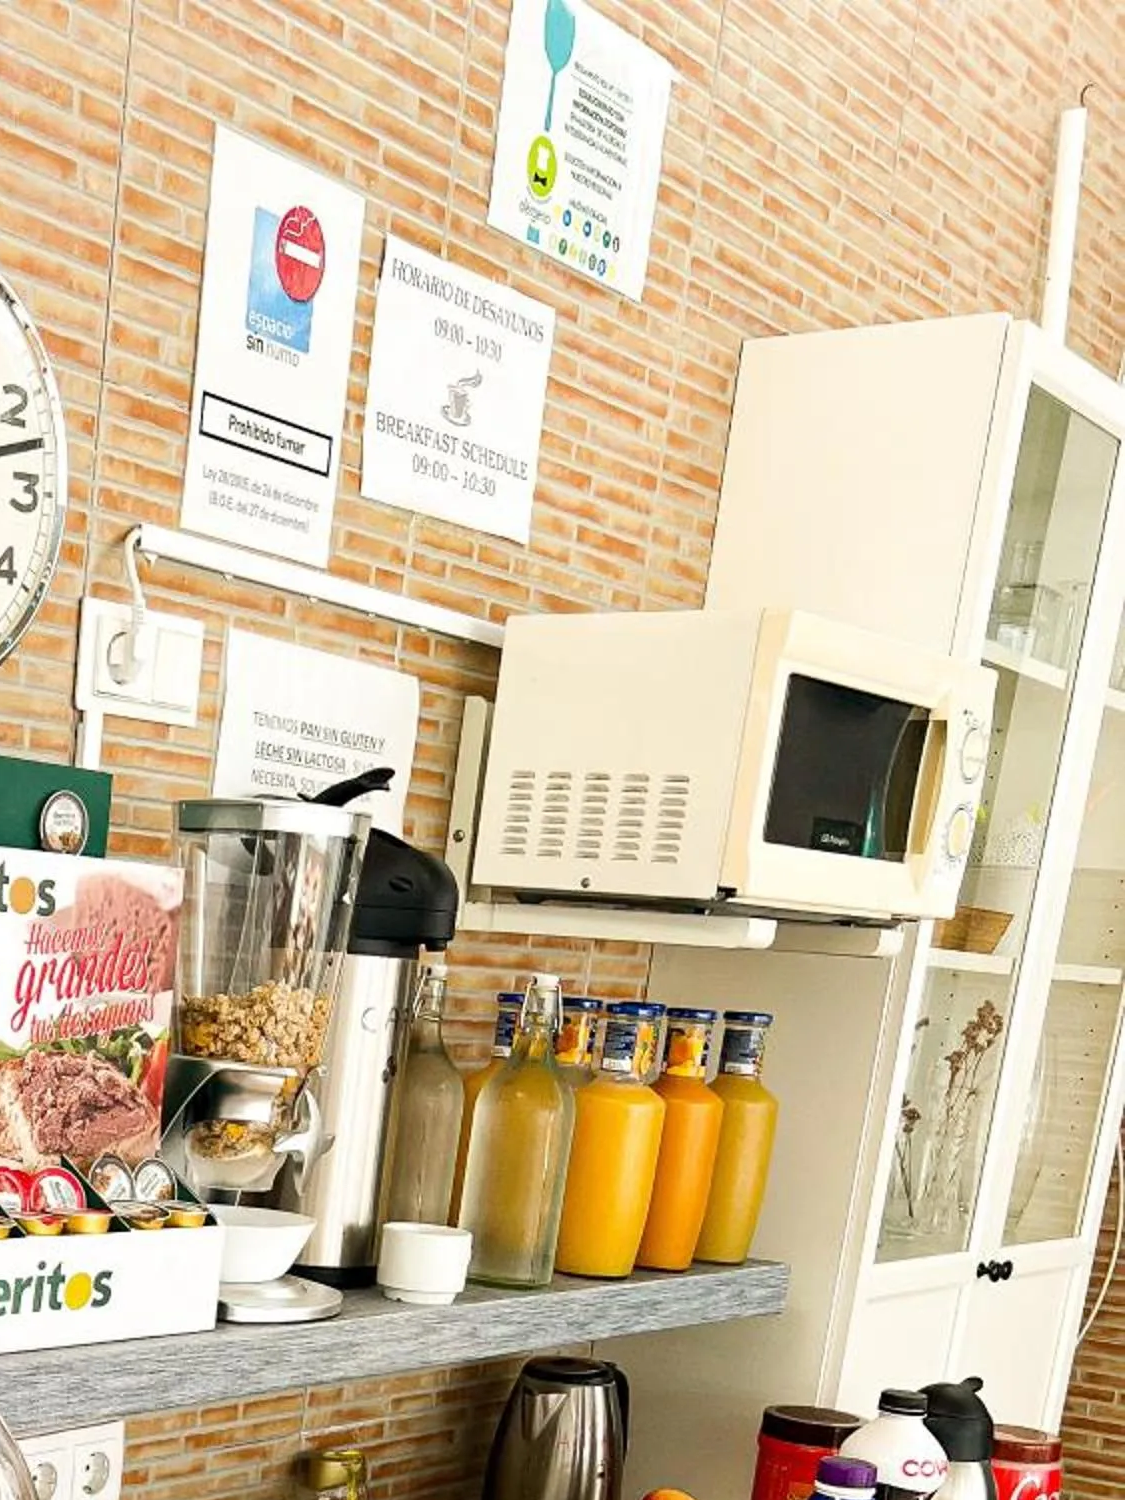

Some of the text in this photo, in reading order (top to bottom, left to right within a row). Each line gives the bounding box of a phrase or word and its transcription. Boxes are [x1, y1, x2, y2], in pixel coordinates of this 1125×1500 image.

[392, 257, 544, 342] HORARIO DE DESAYUNOS
[246, 332, 264, 354] sin
[248, 308, 295, 341] espacio
[434, 316, 464, 346] 09:00
[475, 335, 502, 362] 10:30
[0, 384, 28, 428] 2
[228, 414, 306, 456] Prohibido fumar
[376, 411, 528, 481] BREAKFAST SCHEDULE
[9, 472, 40, 513] 3
[412, 453, 449, 483] 09:00
[462, 470, 496, 497] 10:30
[254, 711, 386, 750] TENEMOS PAN SIN GLUTEN Y
[254, 740, 285, 759] LECHE
[286, 747, 303, 763] SIN
[24, 923, 107, 955] Hacemos
[10, 930, 152, 1032] grandes
[30, 992, 156, 1049] tus desayunos
